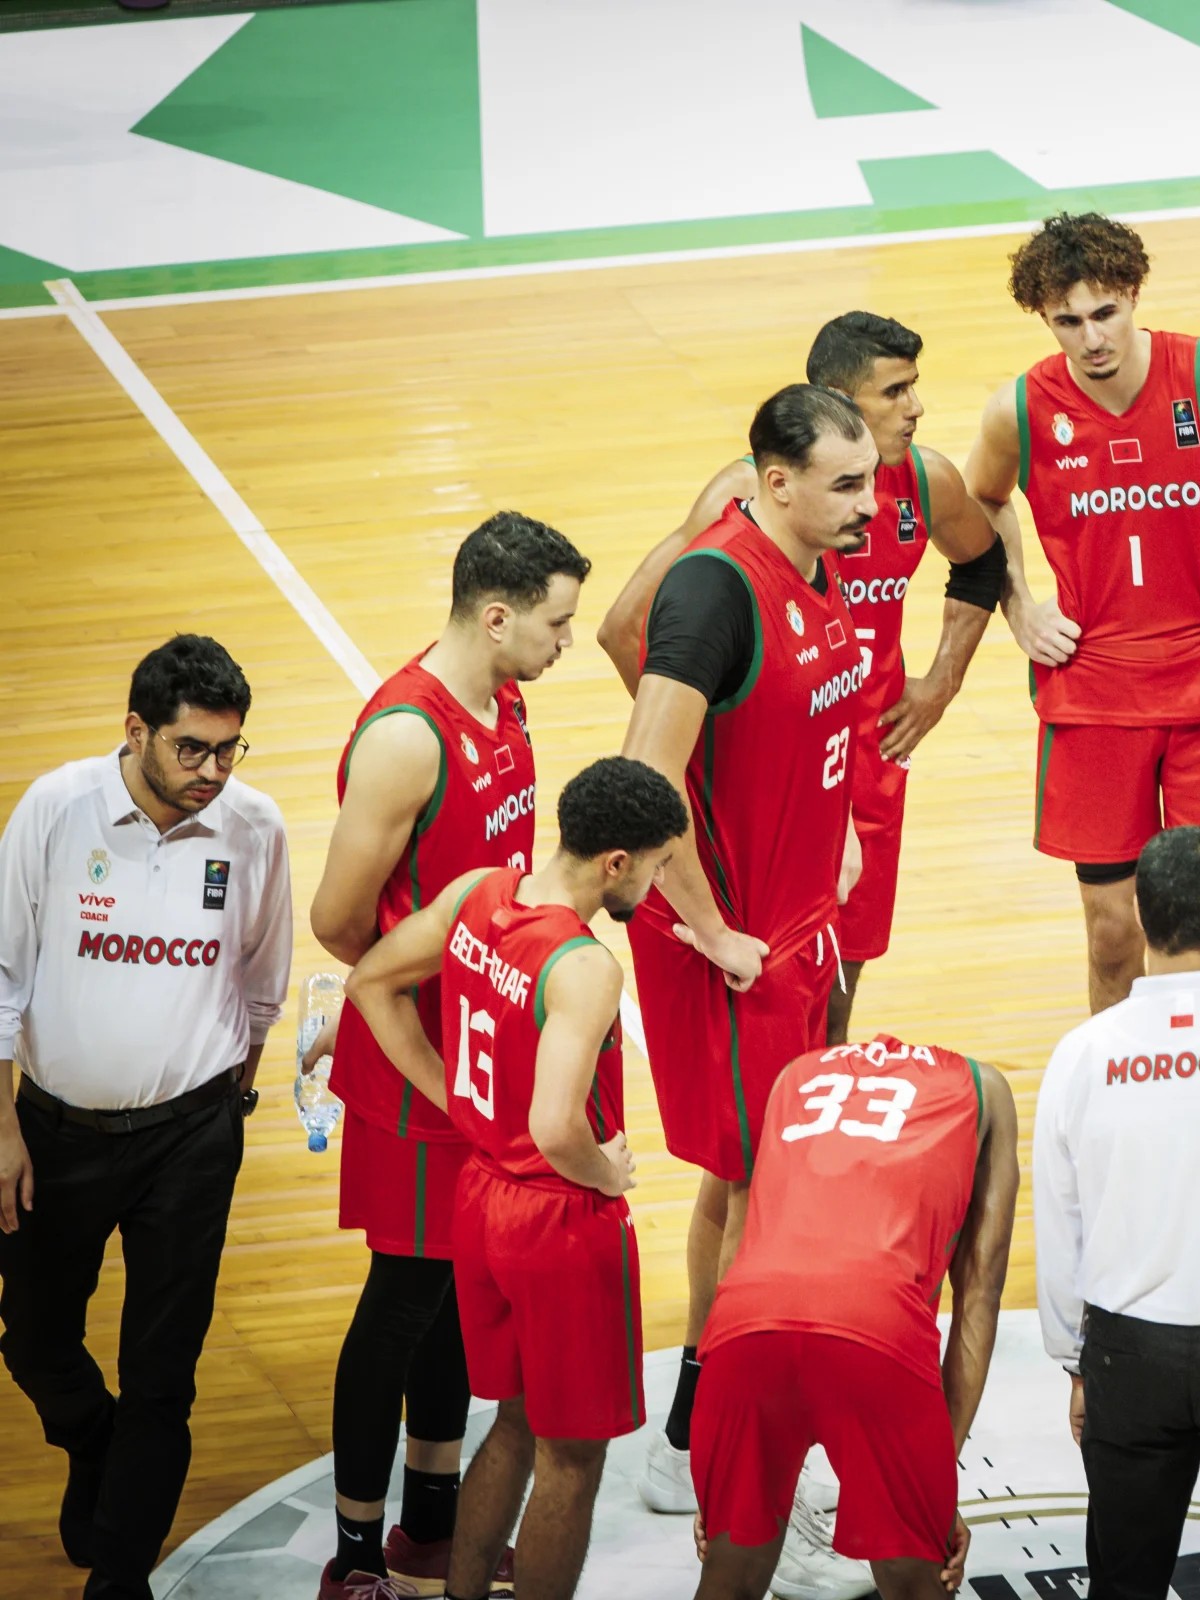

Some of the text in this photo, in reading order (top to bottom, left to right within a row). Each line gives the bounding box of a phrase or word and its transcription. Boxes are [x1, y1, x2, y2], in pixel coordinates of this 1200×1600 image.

[1055, 455, 1089, 470] vive
[1128, 535, 1144, 587] 1
[796, 645, 820, 666] vive
[822, 726, 850, 791] 23
[78, 892, 116, 908] vive
[206, 887, 224, 899] FIBA
[80, 910, 109, 923] COACH
[77, 930, 221, 968] MOROCCO
[453, 994, 495, 1122] 13
[780, 1072, 918, 1143] 33
